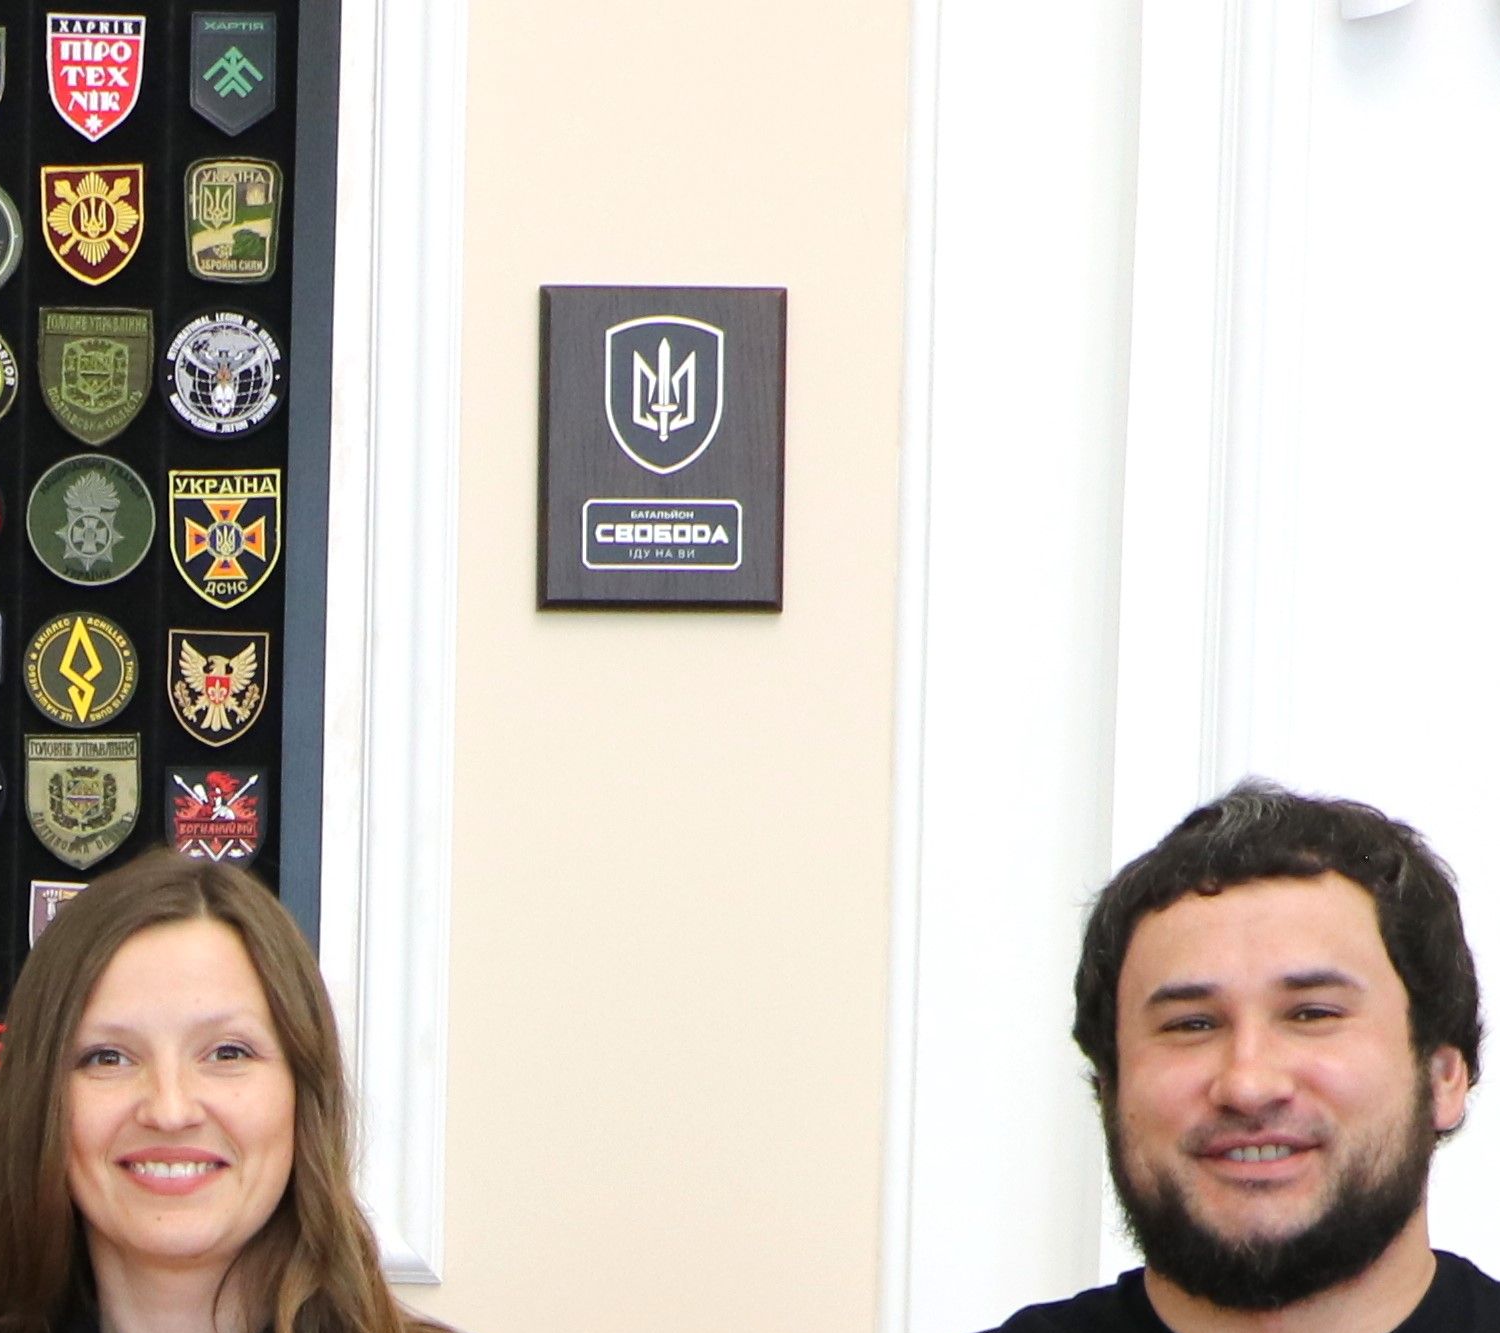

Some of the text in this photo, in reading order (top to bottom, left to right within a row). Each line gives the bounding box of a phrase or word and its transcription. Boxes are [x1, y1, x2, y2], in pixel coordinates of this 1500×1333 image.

[204, 22, 264, 31] ХАРТІЯ
[60, 66, 129, 86] ТЕХ
[175, 477, 274, 494] УКРАЇНА
[631, 509, 694, 520] БАТАЛЬЙОН
[595, 523, 729, 544] СВОБОДА
[629, 548, 695, 559] ІДУ НА ВИ
[204, 581, 248, 596] ДСНС
